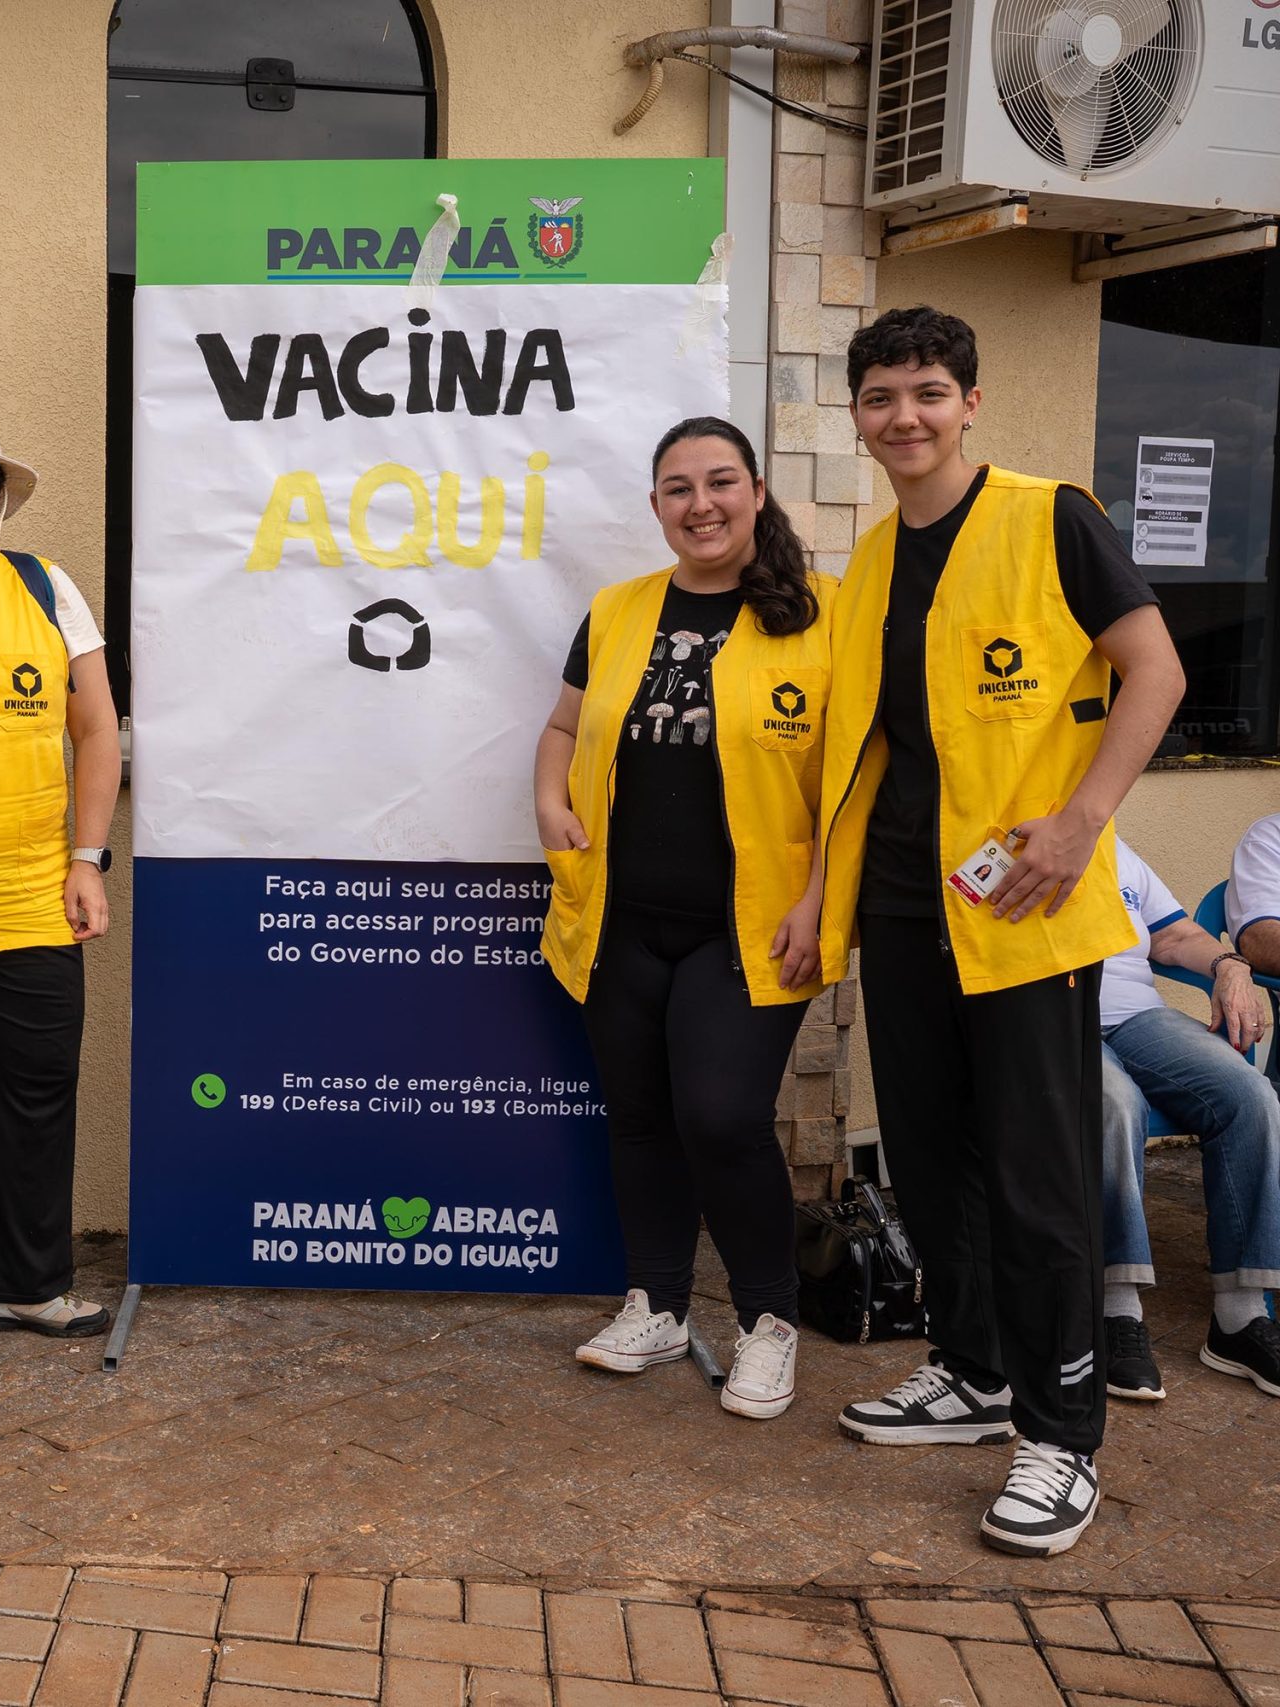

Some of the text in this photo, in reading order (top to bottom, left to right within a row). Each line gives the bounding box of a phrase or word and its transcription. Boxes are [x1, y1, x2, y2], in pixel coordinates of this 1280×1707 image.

[1242, 18, 1280, 50] LG
[267, 218, 520, 270] PARANÁ
[978, 679, 1038, 695] UNICENTRO
[993, 691, 1022, 702] PARANÁ
[4, 699, 48, 711] UNICENTRO
[763, 719, 811, 733] UNICENTRO
[266, 875, 552, 900] Faça aqui seu cadastr
[259, 912, 544, 935] para acessar program
[268, 942, 545, 965] do Governo do Estad
[283, 1073, 590, 1095] Em caso de emergência, ligue
[240, 1094, 608, 1117] 199 (Defesa Civil) ou 193 (Bombeiro
[253, 1198, 559, 1241] PARANÁ ABRAÇA
[252, 1239, 559, 1274] RIO BONITO DO IGUAÇU
